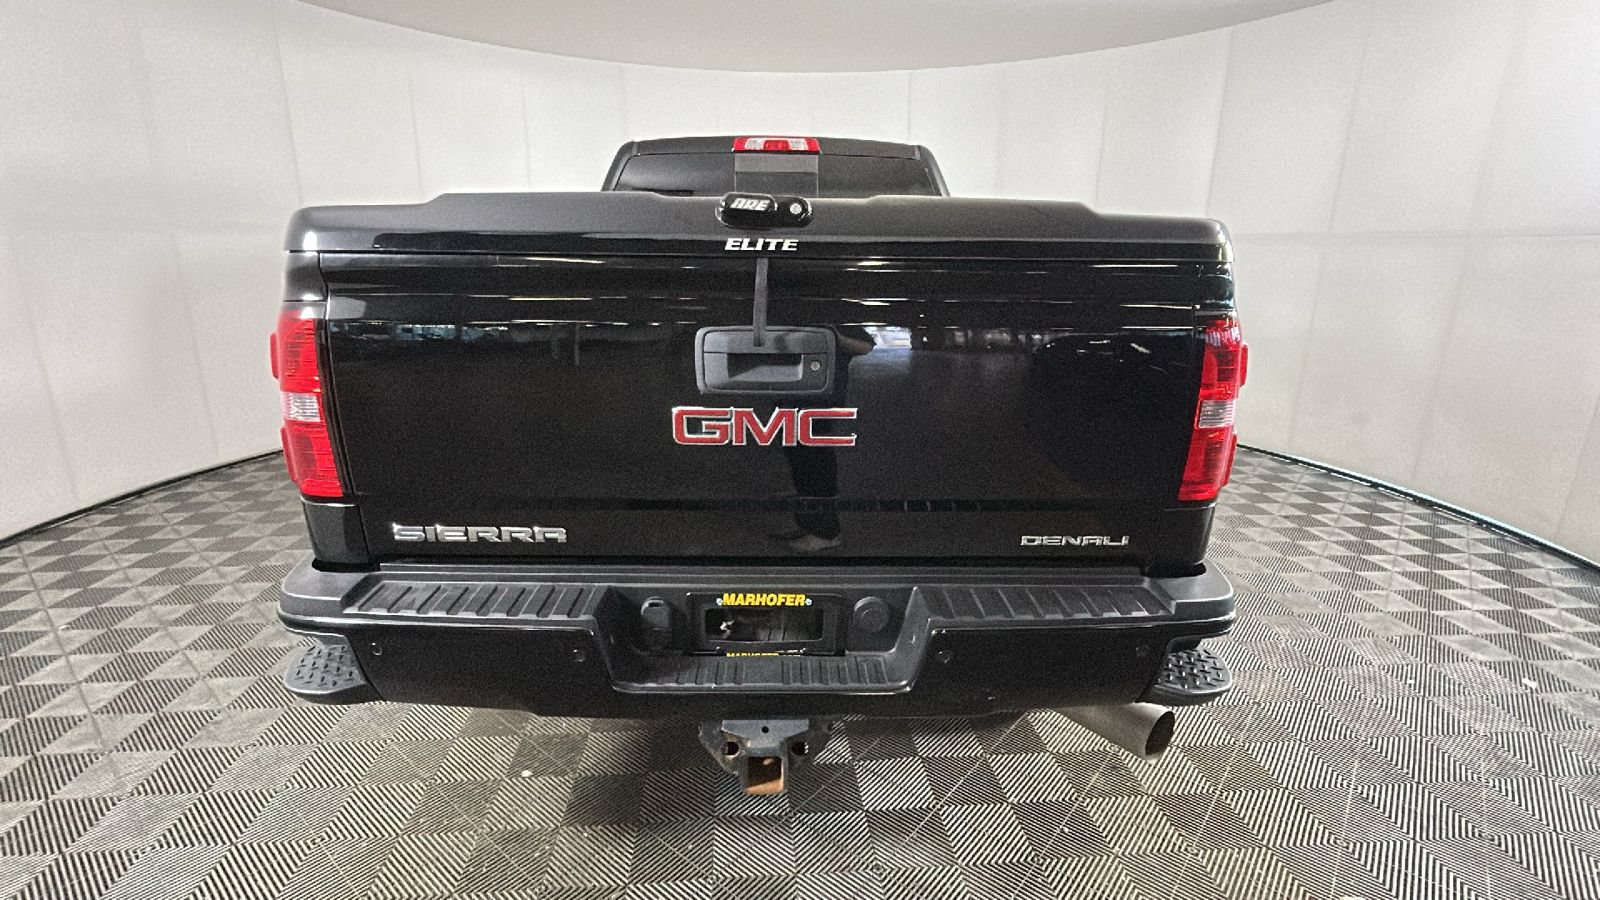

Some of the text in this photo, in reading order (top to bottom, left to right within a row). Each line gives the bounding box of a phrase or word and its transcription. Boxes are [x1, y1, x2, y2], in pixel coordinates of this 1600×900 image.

[725, 238, 799, 251] ELITE
[672, 406, 858, 446] GMC
[392, 523, 567, 543] SIERRA
[1021, 536, 1129, 546] DENALI
[723, 593, 806, 606] MARHOFER
